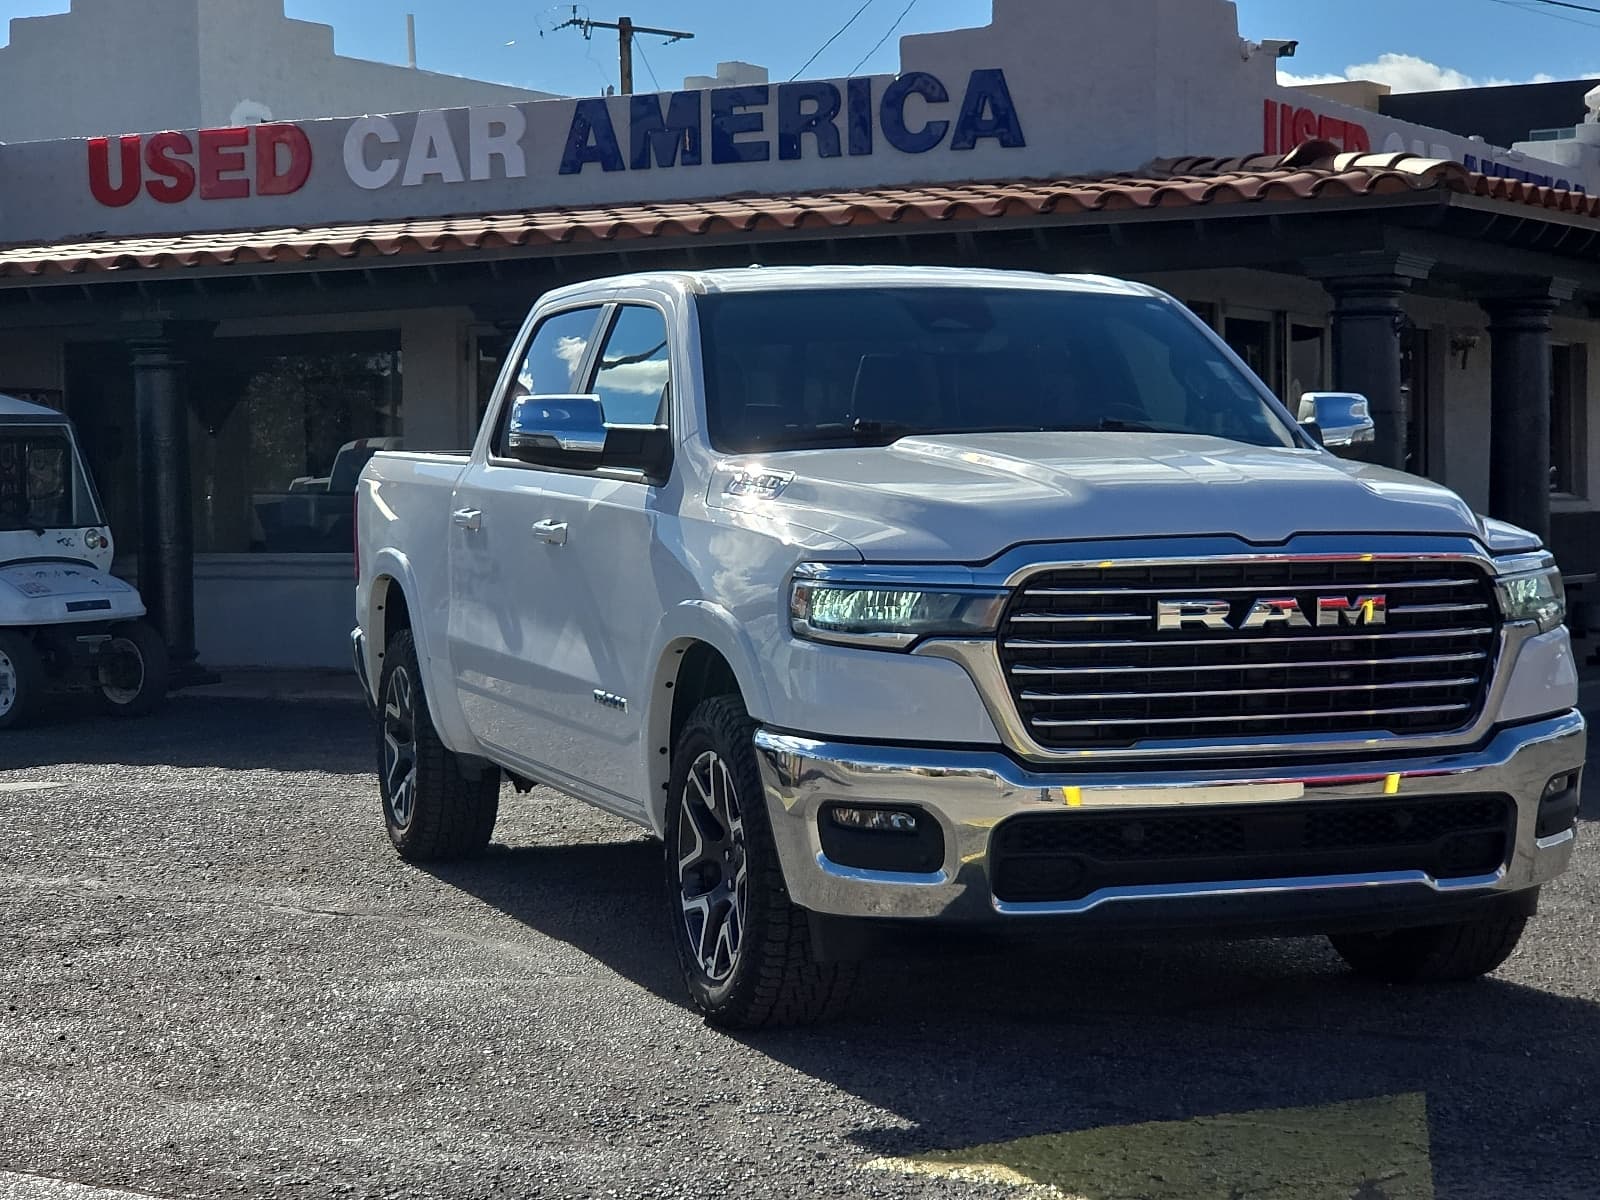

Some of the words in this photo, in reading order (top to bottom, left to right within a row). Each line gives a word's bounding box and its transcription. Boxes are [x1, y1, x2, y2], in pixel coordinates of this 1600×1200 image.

[87, 122, 312, 208] USED
[343, 104, 527, 190] CAR
[558, 69, 1025, 175] AMERICA
[1157, 594, 1386, 631] RAM
